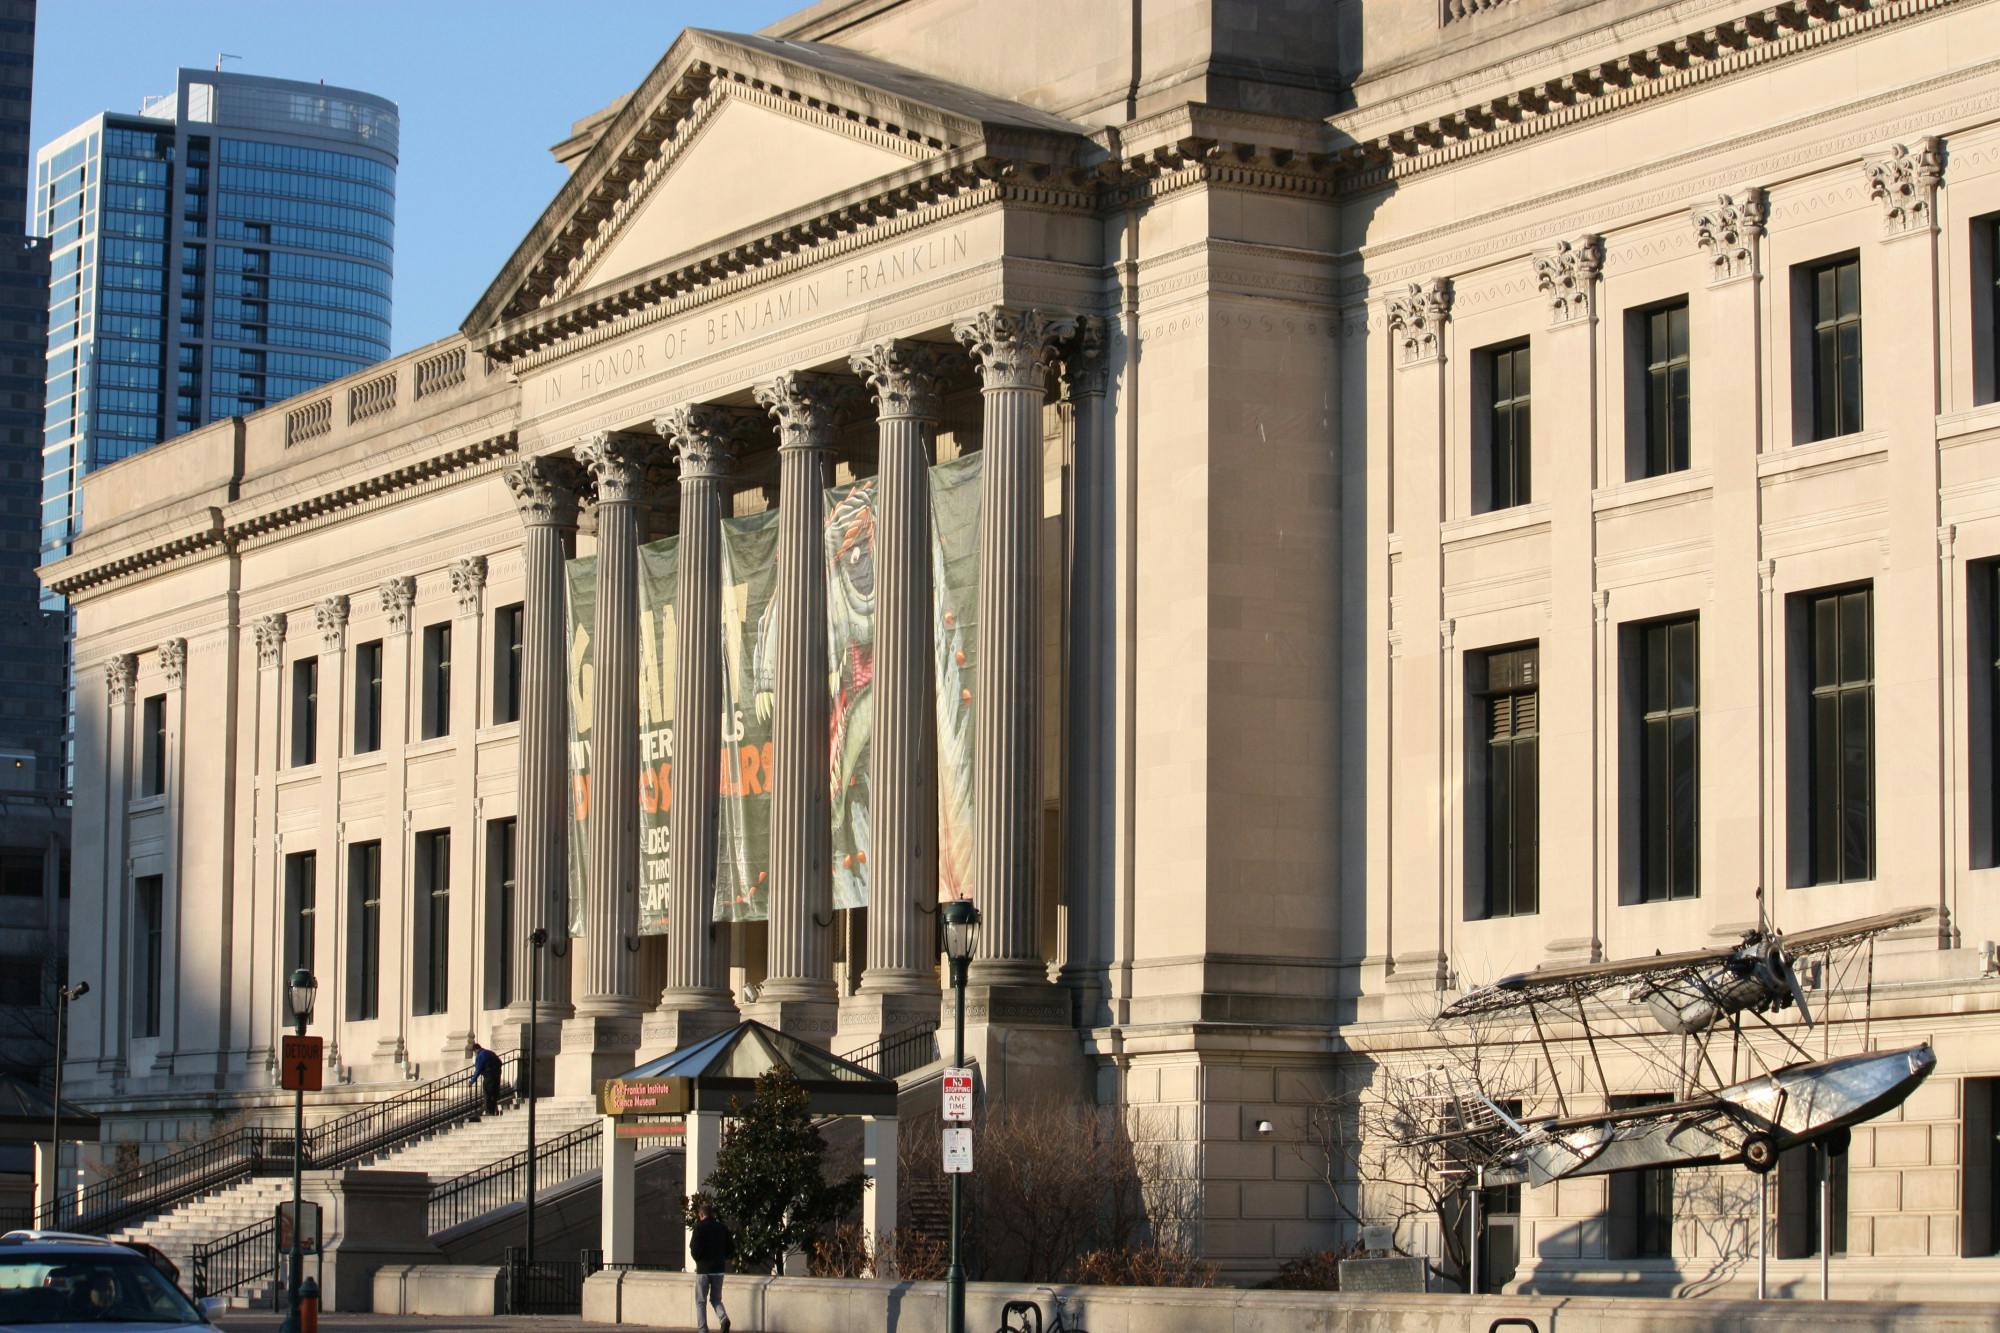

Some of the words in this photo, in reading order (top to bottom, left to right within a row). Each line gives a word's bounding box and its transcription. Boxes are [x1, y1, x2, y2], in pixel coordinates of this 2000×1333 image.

[545, 374, 563, 404] IN
[580, 344, 646, 390] HONOR
[664, 328, 688, 361] OF
[707, 279, 821, 346] BENJAMIN
[846, 229, 969, 298] FRANKLIN
[284, 1043, 320, 1059] DETOUR
[952, 1077, 963, 1087] NO
[624, 1083, 647, 1096] Franklin
[647, 1083, 669, 1095] Institute
[614, 1097, 634, 1108] Science
[634, 1095, 657, 1107] Museum
